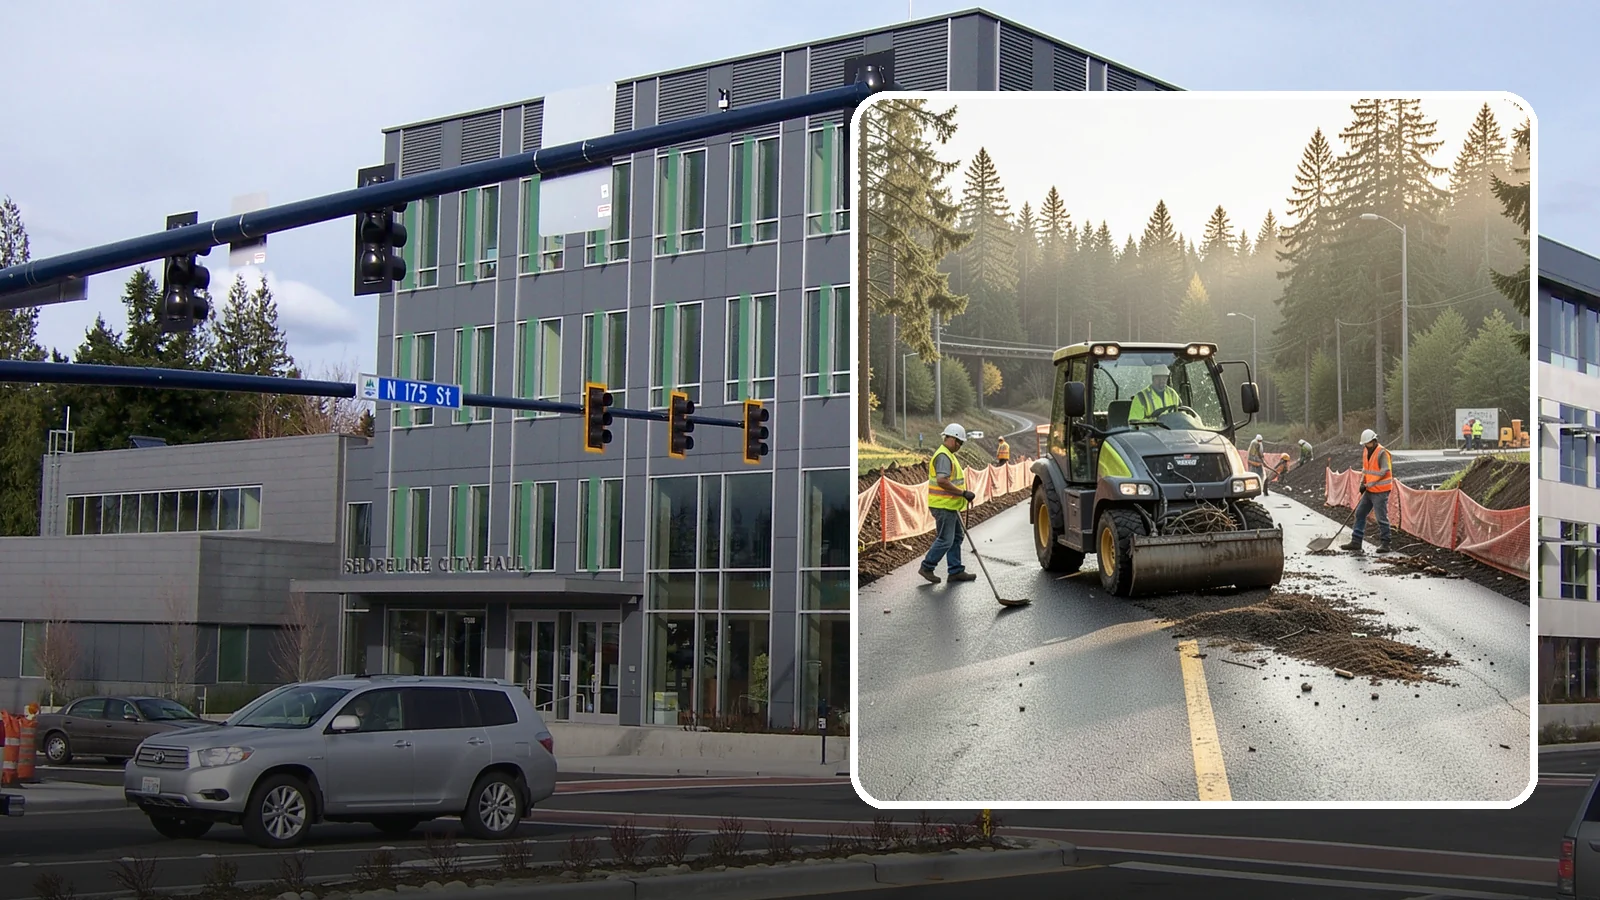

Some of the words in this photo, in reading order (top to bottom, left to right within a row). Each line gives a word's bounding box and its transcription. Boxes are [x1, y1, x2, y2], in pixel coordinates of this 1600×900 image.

[387, 380, 396, 399] N
[405, 382, 427, 403] 175
[436, 386, 451, 406] St
[343, 557, 432, 574] SHORELINE
[438, 557, 476, 572] CITY
[484, 556, 526, 571] HALL
